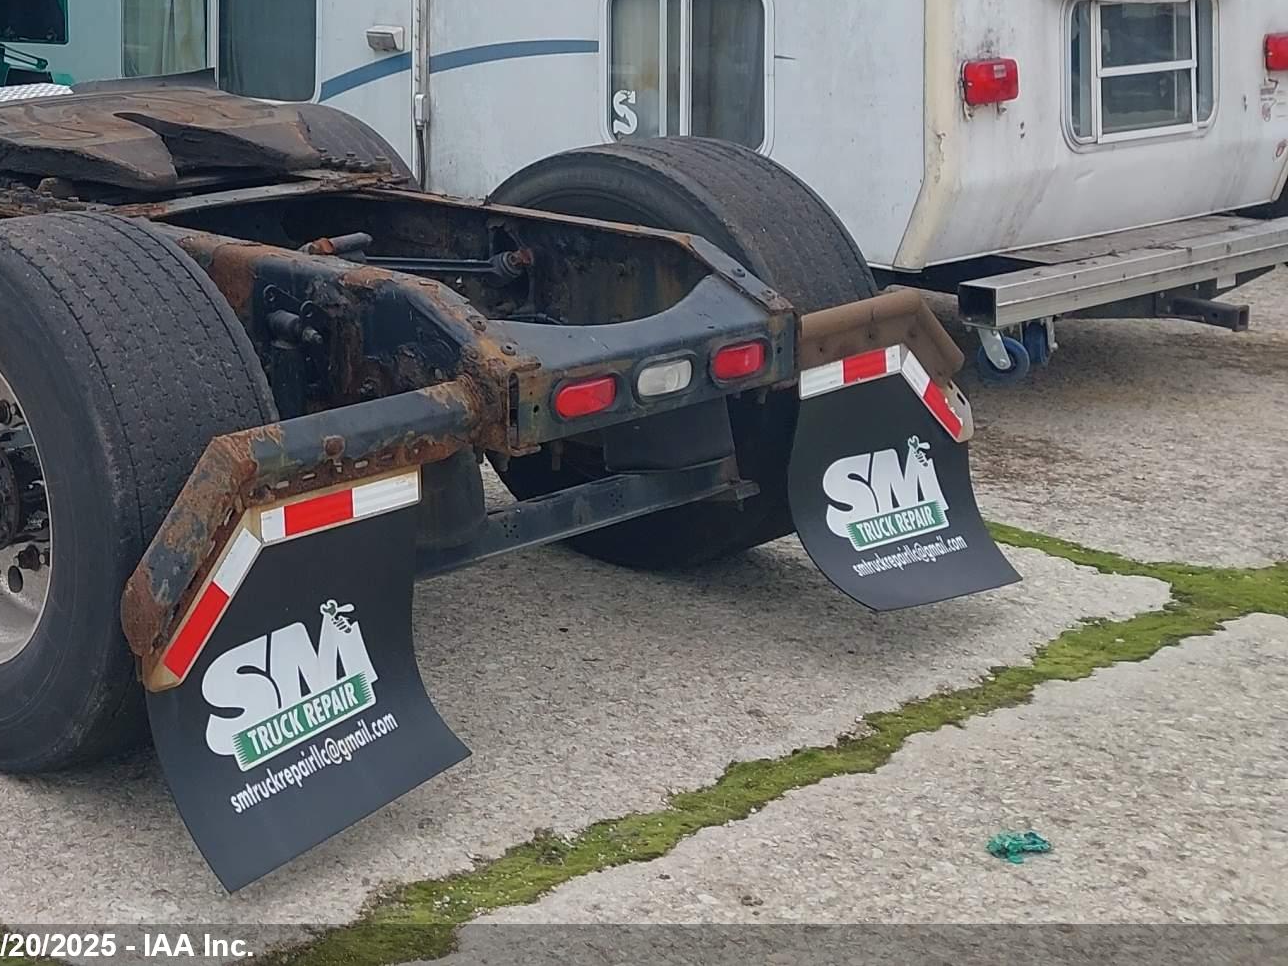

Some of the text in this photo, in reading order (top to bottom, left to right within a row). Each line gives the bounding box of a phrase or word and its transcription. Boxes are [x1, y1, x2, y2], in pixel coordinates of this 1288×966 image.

[613, 90, 638, 135] S
[822, 444, 949, 539] SM
[856, 505, 936, 544] TRUCK REPAIR
[201, 609, 379, 756] SM
[247, 681, 359, 756] TRUCK REPAIR
[230, 712, 399, 814] smtruckrepairllc@gmail.com
